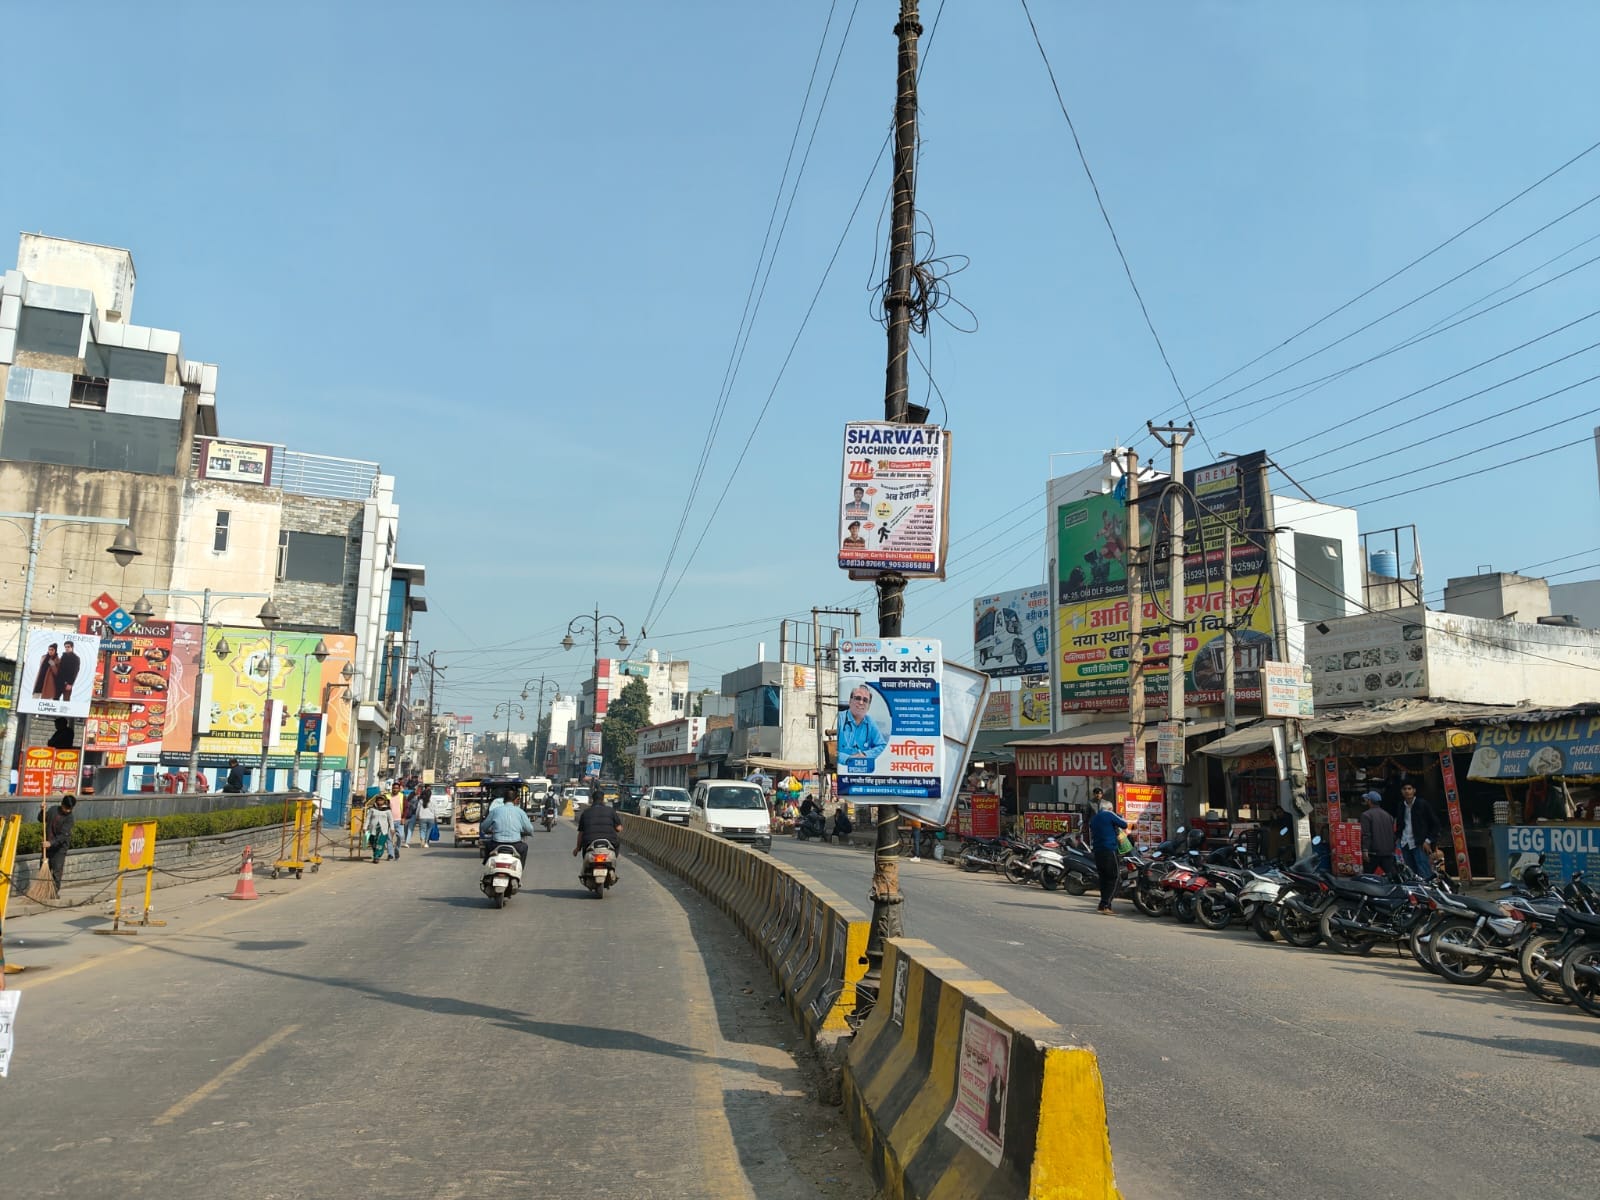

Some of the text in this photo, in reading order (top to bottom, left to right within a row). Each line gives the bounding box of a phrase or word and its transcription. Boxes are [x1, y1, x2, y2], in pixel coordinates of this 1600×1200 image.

[848, 430, 940, 445] SHARWATI
[847, 446, 939, 455] COACHING CAMPUS
[1197, 465, 1237, 484] ARENA
[843, 656, 935, 676] डॉ. संजीव अरोड़ा
[1480, 724, 1521, 746] EGG
[1526, 719, 1580, 743] ROLL
[1017, 752, 1058, 771] VINITA
[1062, 752, 1108, 772] HOTEL
[1502, 750, 1531, 759] PANEER
[890, 762, 933, 772] अस्पताल
[1503, 764, 1521, 773] ROLL
[1573, 762, 1593, 771] ROLL
[1508, 828, 1599, 853] EGG ROLL
